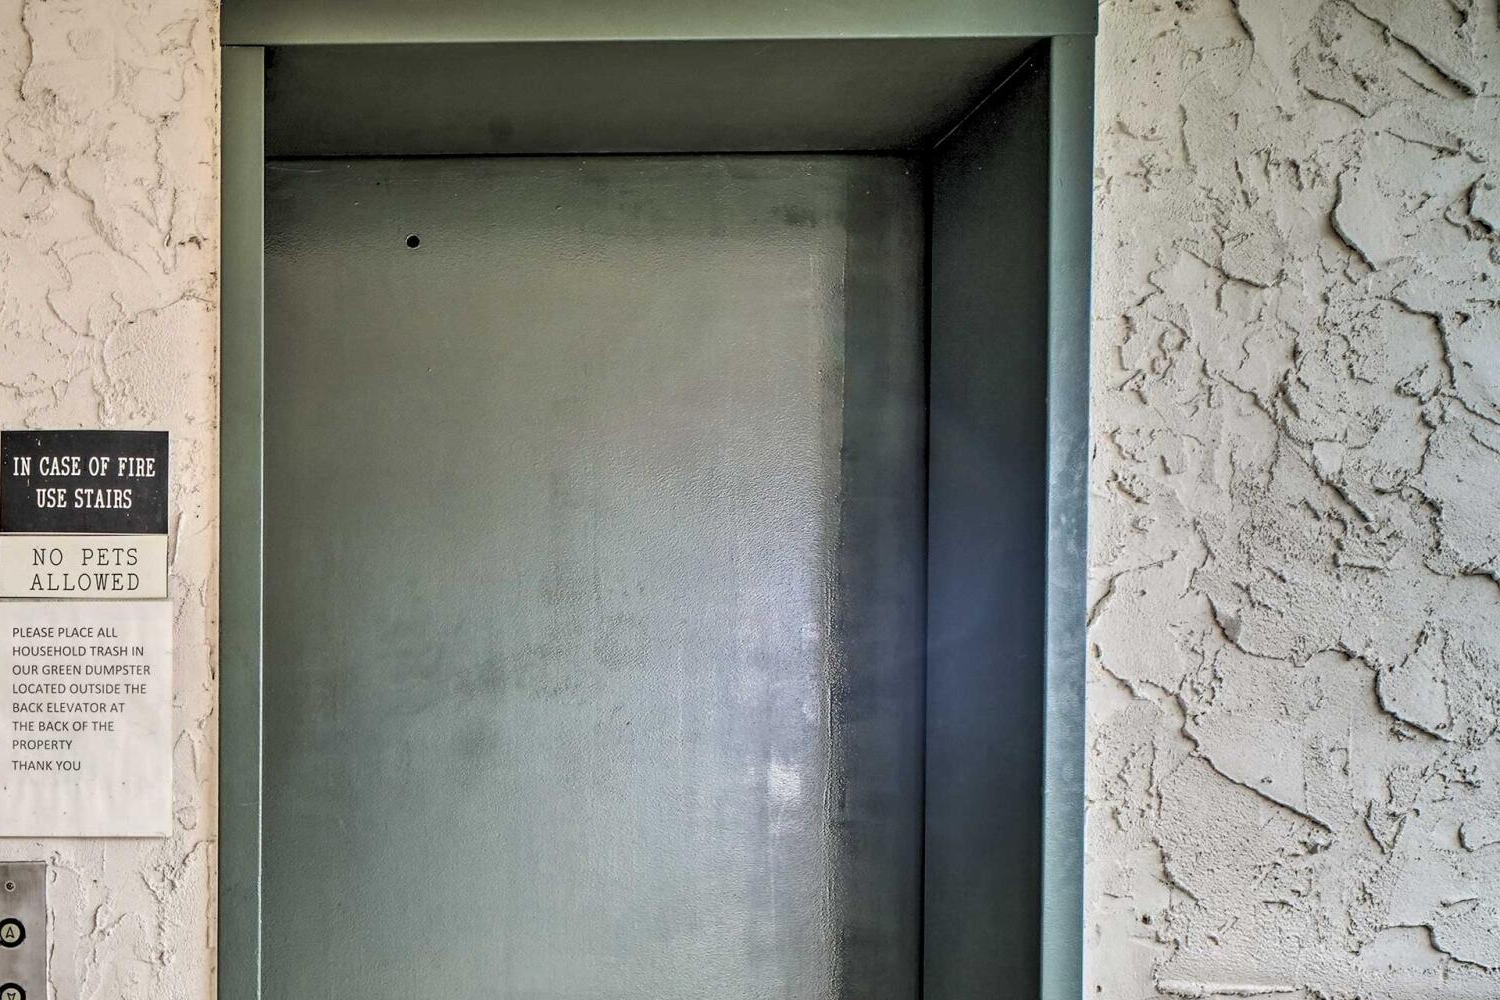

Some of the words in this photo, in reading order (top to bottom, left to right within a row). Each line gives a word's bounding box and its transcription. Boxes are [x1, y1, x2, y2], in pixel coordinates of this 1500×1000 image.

[13, 456, 32, 477] IN
[39, 455, 81, 477] CASE
[88, 456, 110, 477] OF
[117, 457, 156, 478] FIRE
[36, 487, 67, 509] USE
[74, 488, 132, 509] STAIRS
[32, 548, 63, 566] NO
[81, 548, 138, 566] PETS
[29, 572, 140, 592] ALLOWED
[12, 627, 54, 638] PLEASE
[58, 627, 94, 638] PLACE
[97, 627, 118, 638] ALL
[12, 646, 87, 657] HOUSEHOLD
[90, 646, 128, 657] TRASH
[131, 646, 144, 657] IN
[12, 664, 39, 675] OUR
[42, 664, 82, 675] GREEN
[85, 664, 151, 676] DUMPSTER
[12, 683, 66, 694] LOCATED
[69, 683, 121, 694] OUTSIDE
[124, 683, 146, 694] THE
[12, 702, 44, 713] BACK
[46, 702, 107, 713] ELEVATOR
[110, 702, 125, 713] AT
[12, 721, 35, 732] THE
[38, 721, 69, 732] BACK
[72, 721, 88, 732] OF
[92, 721, 115, 732] THE
[12, 739, 73, 750] PROPERTY
[12, 760, 53, 771] THANK
[55, 760, 81, 771] YOU
